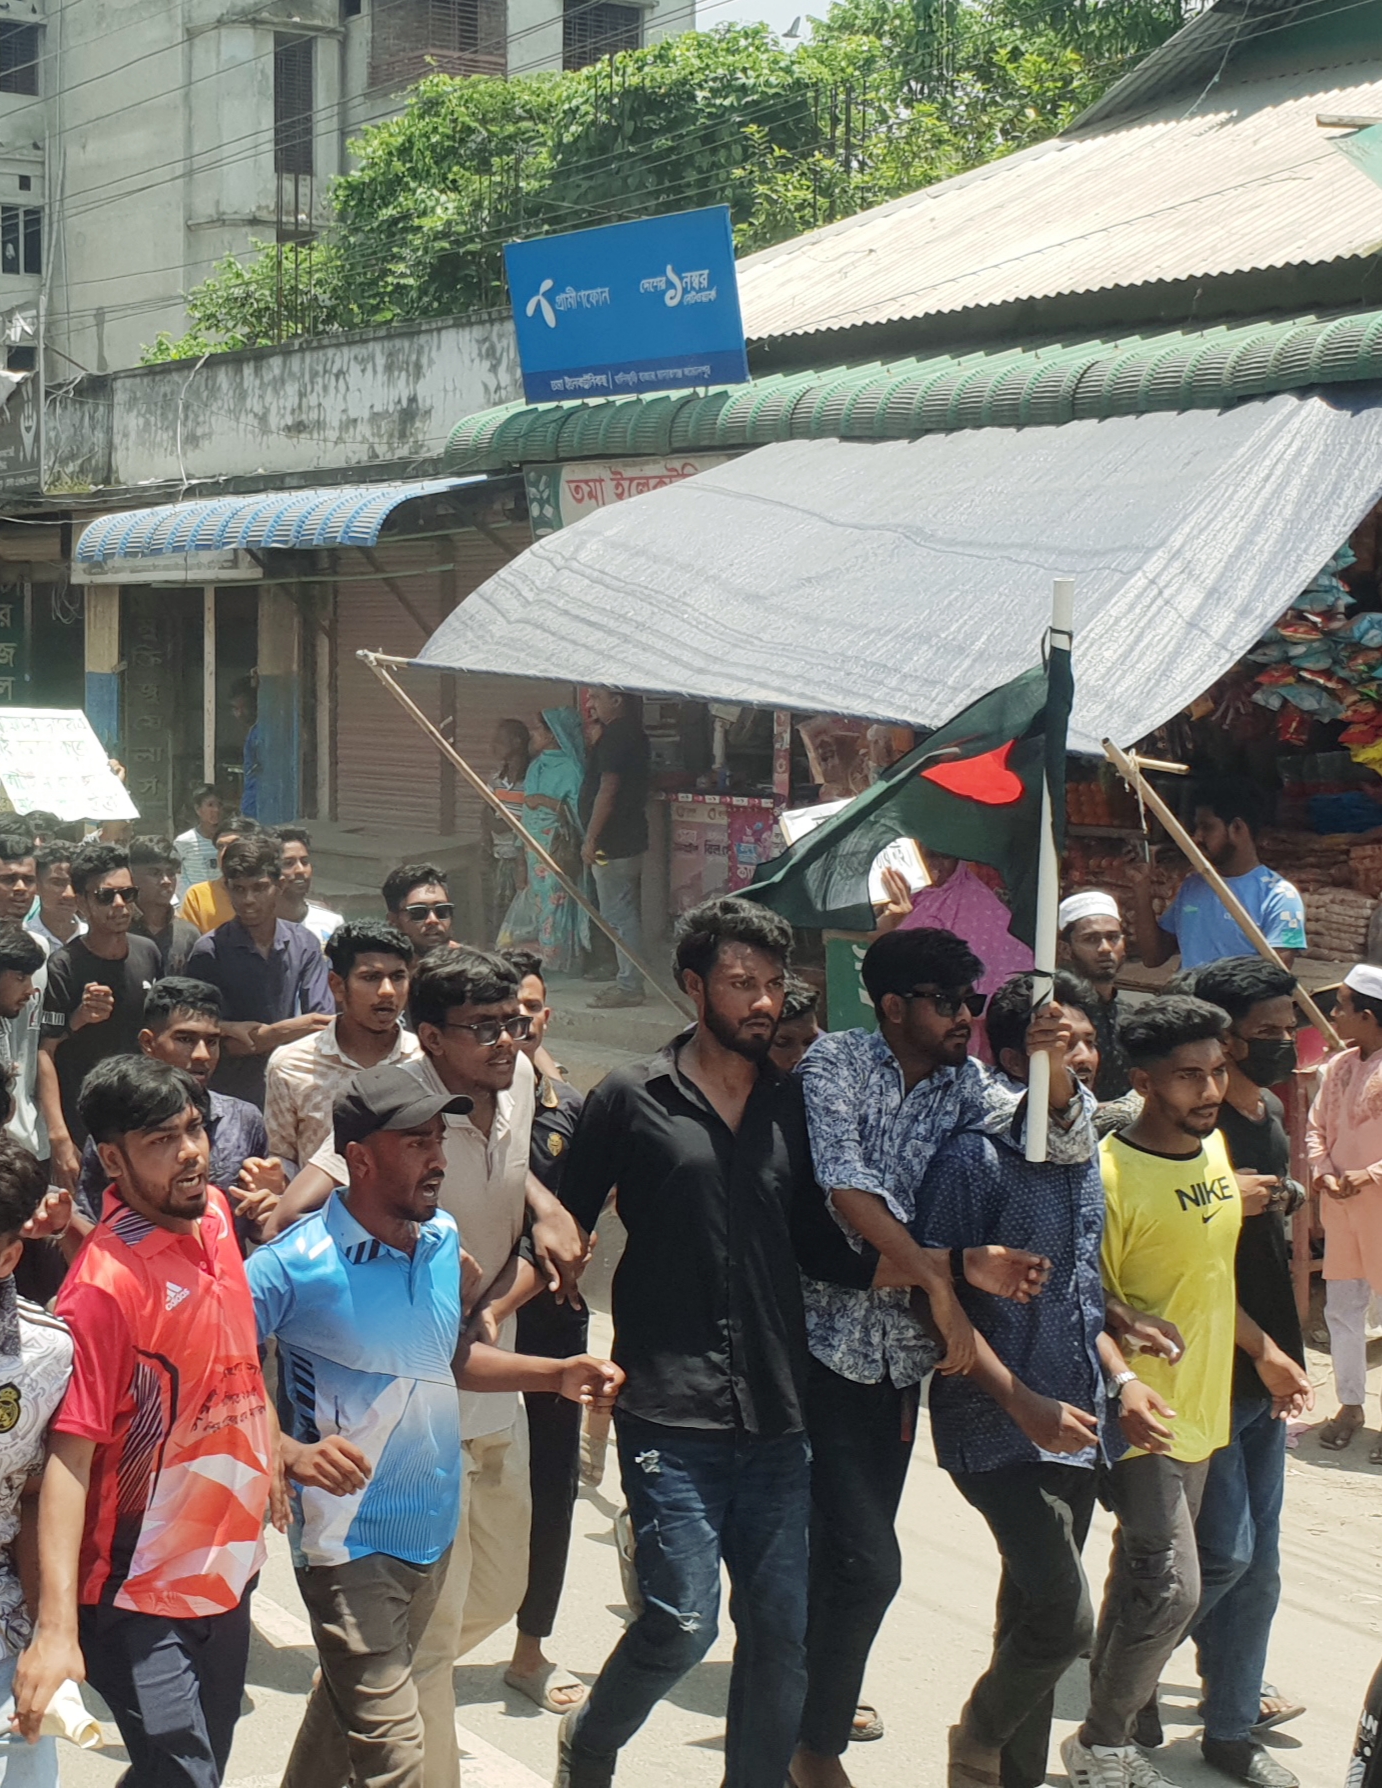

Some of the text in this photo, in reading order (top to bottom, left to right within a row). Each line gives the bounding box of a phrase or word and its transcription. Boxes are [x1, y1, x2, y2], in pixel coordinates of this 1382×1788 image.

[639, 276, 667, 294] দেশের
[682, 269, 710, 291] নম্বর
[555, 286, 611, 311] গ্রামীণফোন
[565, 478, 606, 505] তমা
[1174, 1176, 1234, 1211] NIKE
[166, 1288, 190, 1311] adidas
